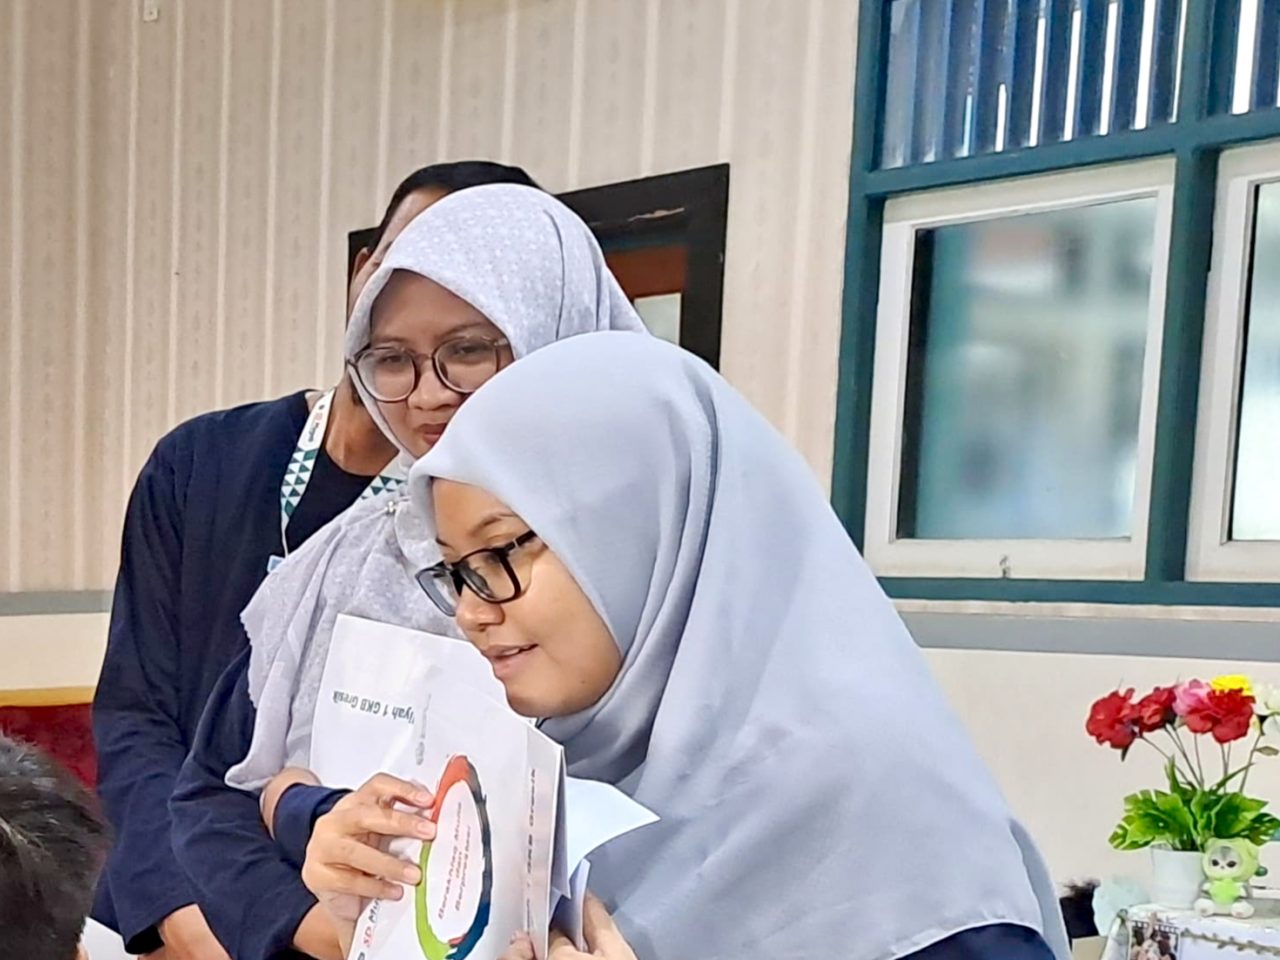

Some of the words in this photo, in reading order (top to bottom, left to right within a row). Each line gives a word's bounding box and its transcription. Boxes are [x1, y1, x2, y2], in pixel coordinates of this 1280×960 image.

[332, 691, 359, 709] Gresik
[359, 698, 381, 715] GKB
[392, 706, 415, 725] iyah
